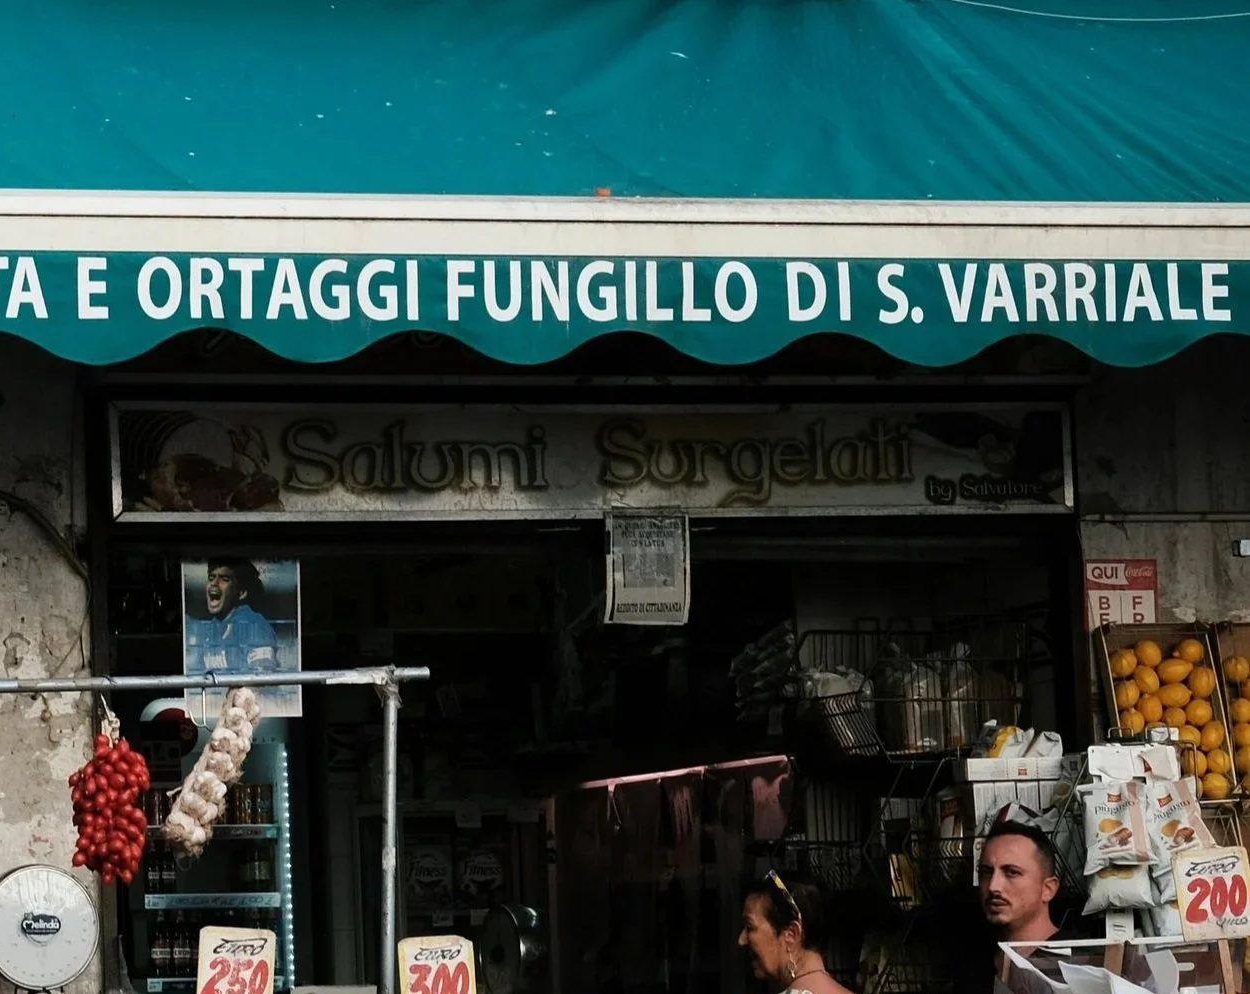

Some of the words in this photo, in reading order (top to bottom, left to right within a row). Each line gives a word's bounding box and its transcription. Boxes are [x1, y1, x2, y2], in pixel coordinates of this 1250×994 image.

[77, 256, 110, 320] E
[137, 256, 419, 322] ORTAGGI
[447, 258, 758, 323] FUNGILLO
[785, 261, 851, 322] DI
[877, 263, 925, 325] S.
[937, 262, 1232, 323] VARRIALE
[283, 418, 549, 491] Salumi
[599, 417, 916, 507] Surgelati
[926, 476, 957, 504] by
[959, 474, 1045, 499] Salvatore
[1091, 566, 1118, 579] QUI
[1185, 856, 1240, 877] EURO
[22, 918, 60, 930] Melinda
[213, 938, 268, 956] EURO
[414, 944, 463, 962] EURO
